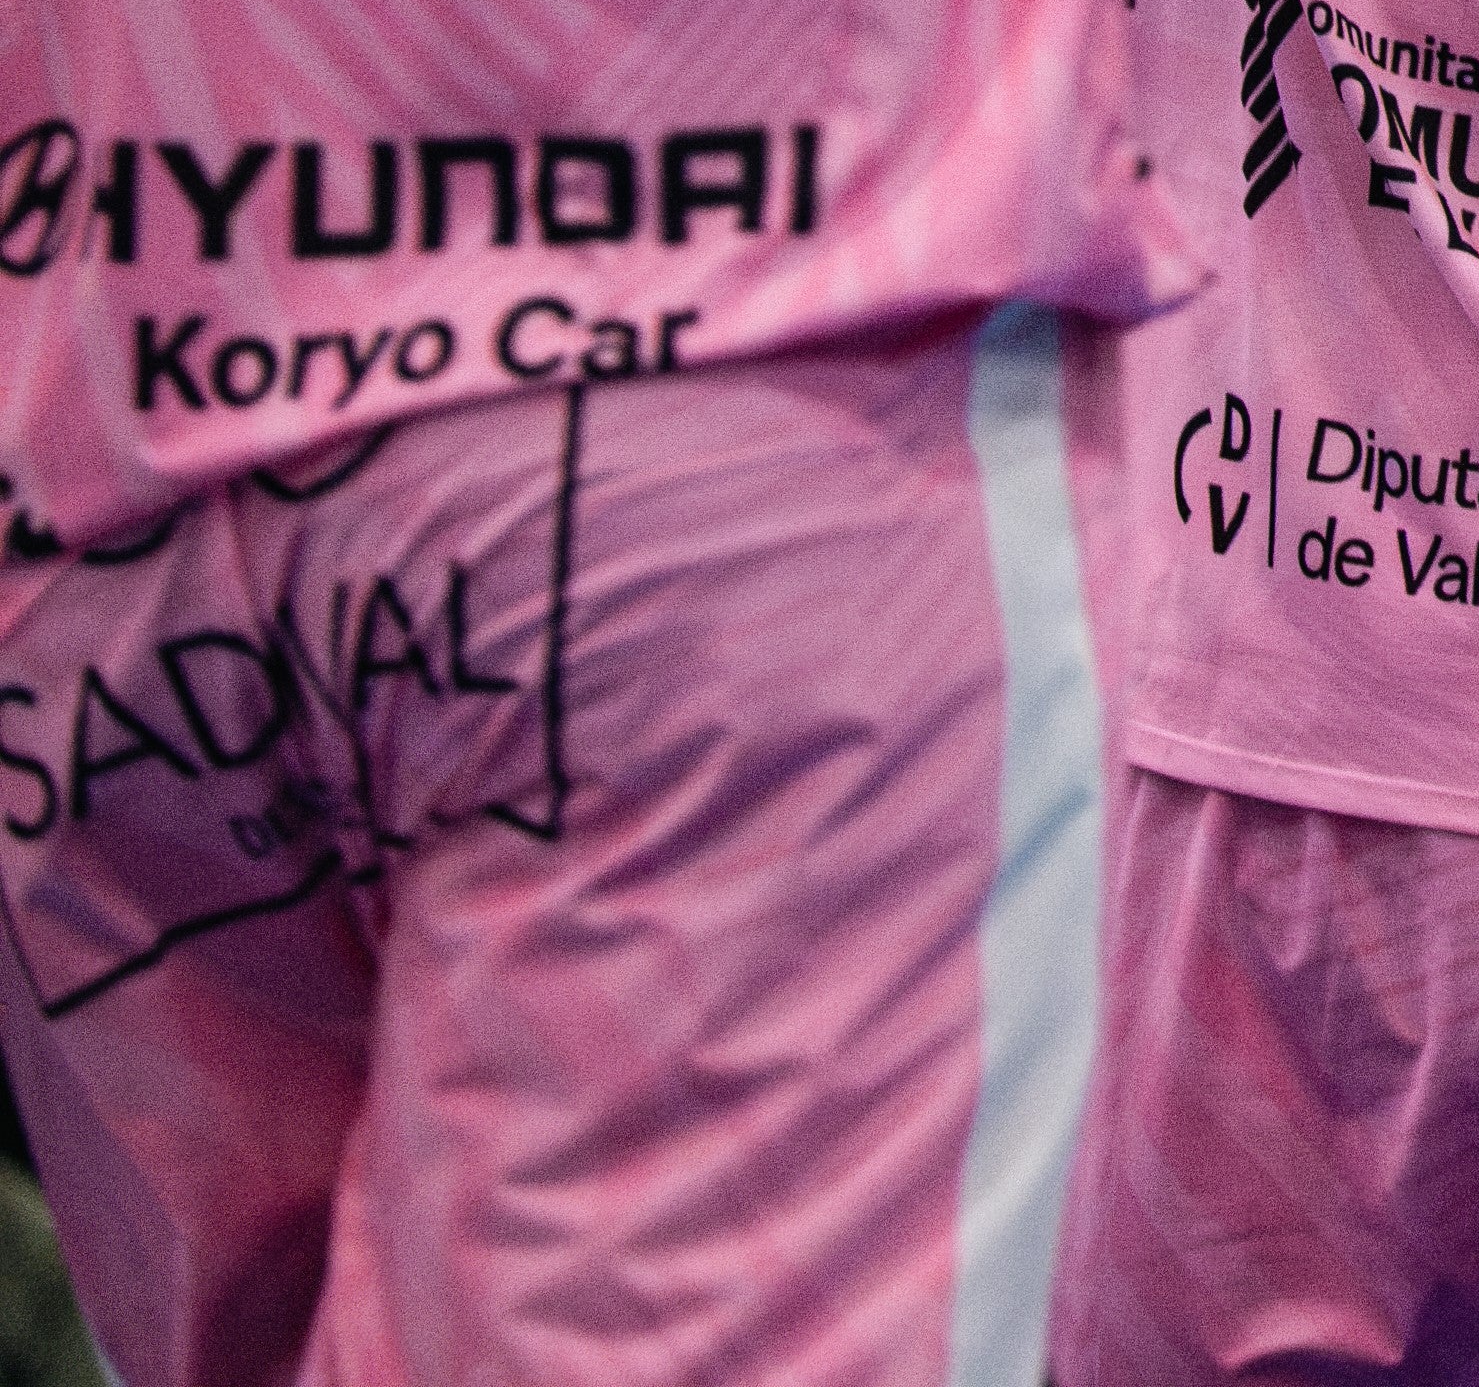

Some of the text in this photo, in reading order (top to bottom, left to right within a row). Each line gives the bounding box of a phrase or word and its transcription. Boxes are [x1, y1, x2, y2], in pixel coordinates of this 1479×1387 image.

[132, 296, 699, 413] Koryo Car
[1297, 515, 1376, 588] de
